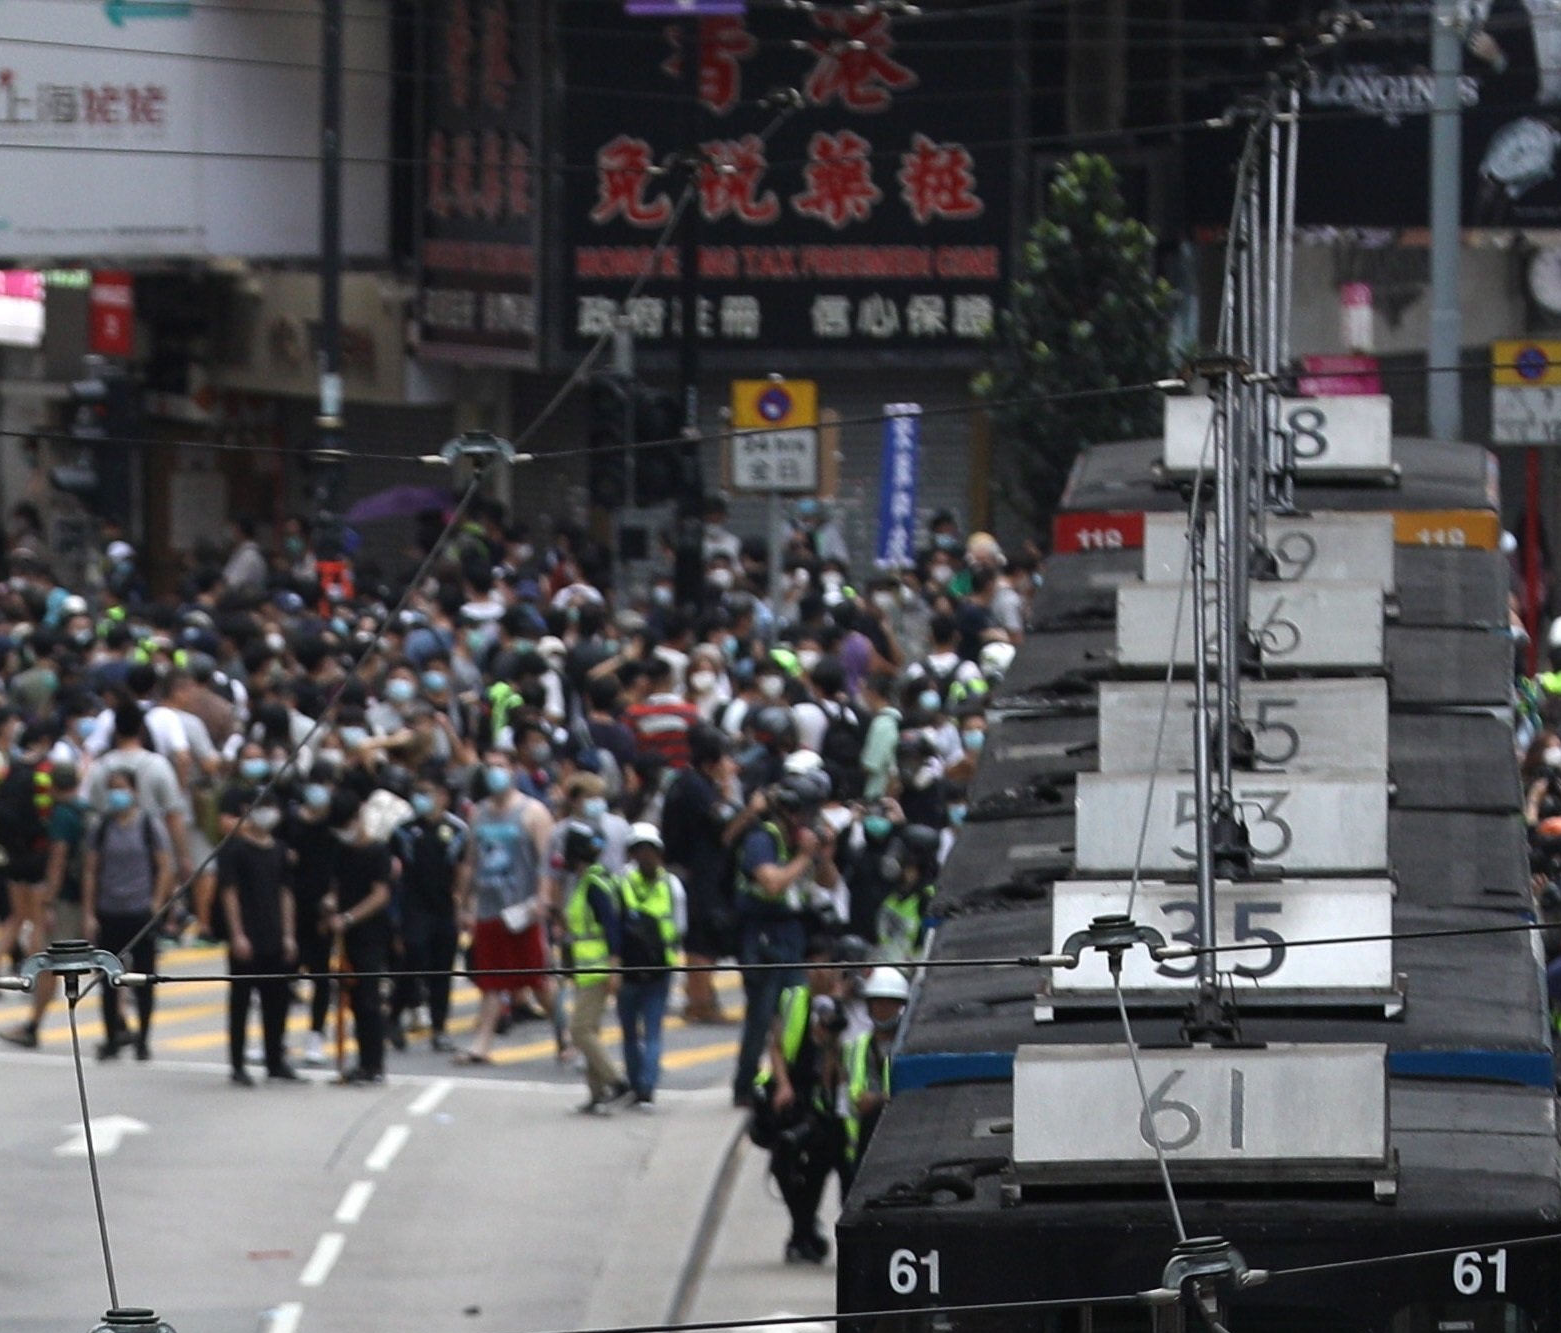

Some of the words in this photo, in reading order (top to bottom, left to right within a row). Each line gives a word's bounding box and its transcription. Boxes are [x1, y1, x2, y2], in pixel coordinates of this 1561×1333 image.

[1307, 75, 1480, 106] LONGINS
[1157, 902, 1288, 979] 35
[1139, 1068, 1245, 1151] 61
[887, 1248, 941, 1295] 61
[1452, 1248, 1508, 1295] 61
